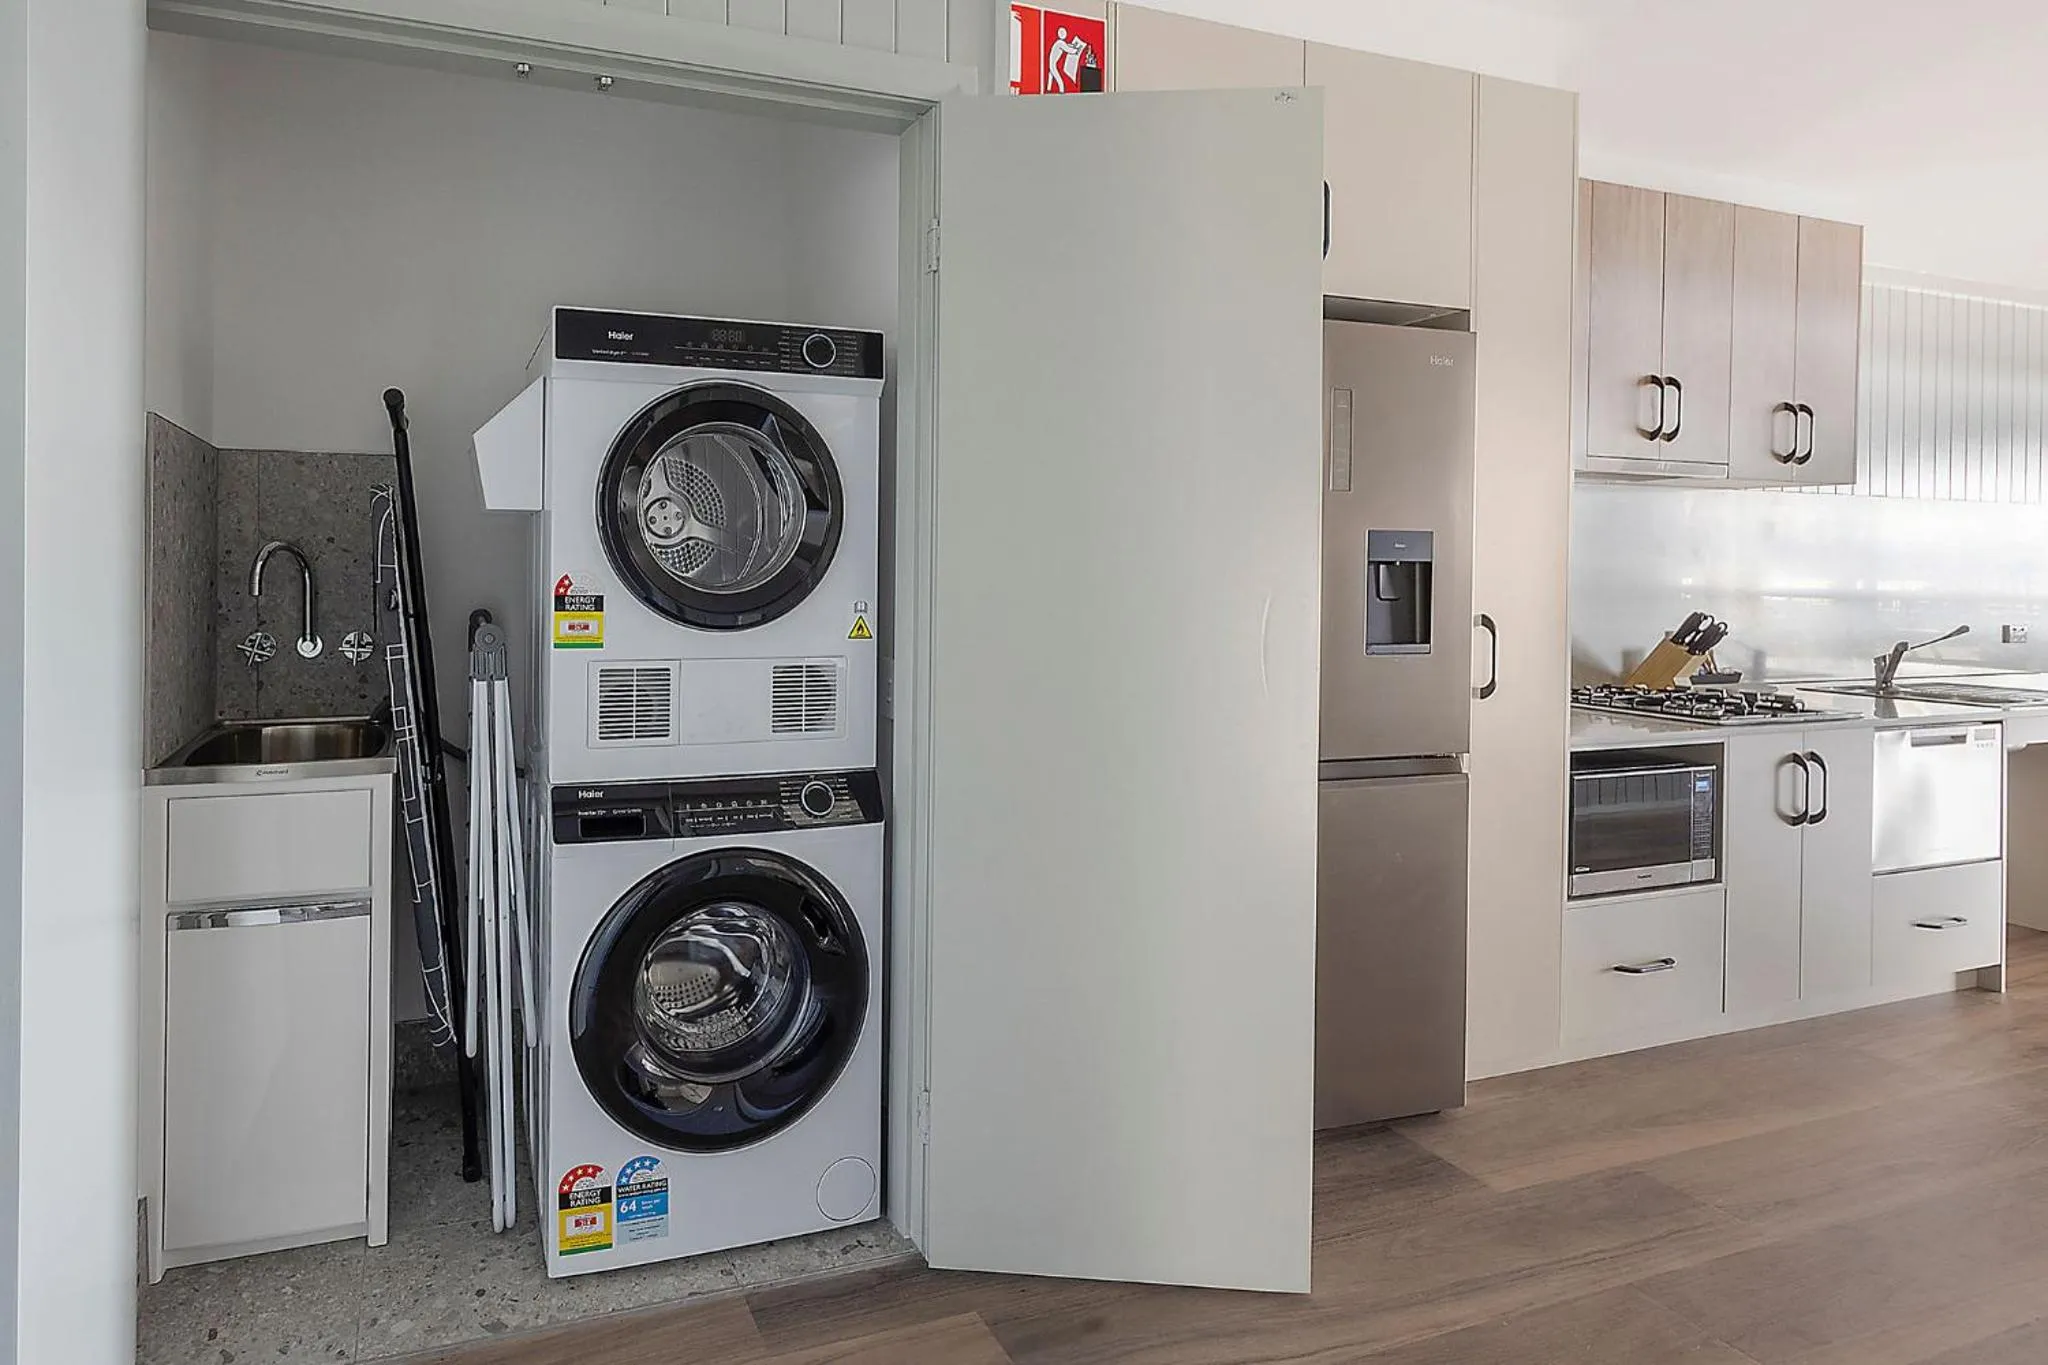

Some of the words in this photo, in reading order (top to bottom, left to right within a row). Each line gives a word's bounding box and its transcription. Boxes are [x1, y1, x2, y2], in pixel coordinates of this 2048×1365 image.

[608, 330, 634, 341] Haier
[564, 596, 596, 604] ENERGY
[578, 789, 604, 799] Haier
[618, 1183, 641, 1193] WATER
[641, 1179, 667, 1189] RATING
[568, 1189, 602, 1200] ENERGY
[569, 1197, 602, 1208] RATING
[620, 1199, 637, 1214] 64
